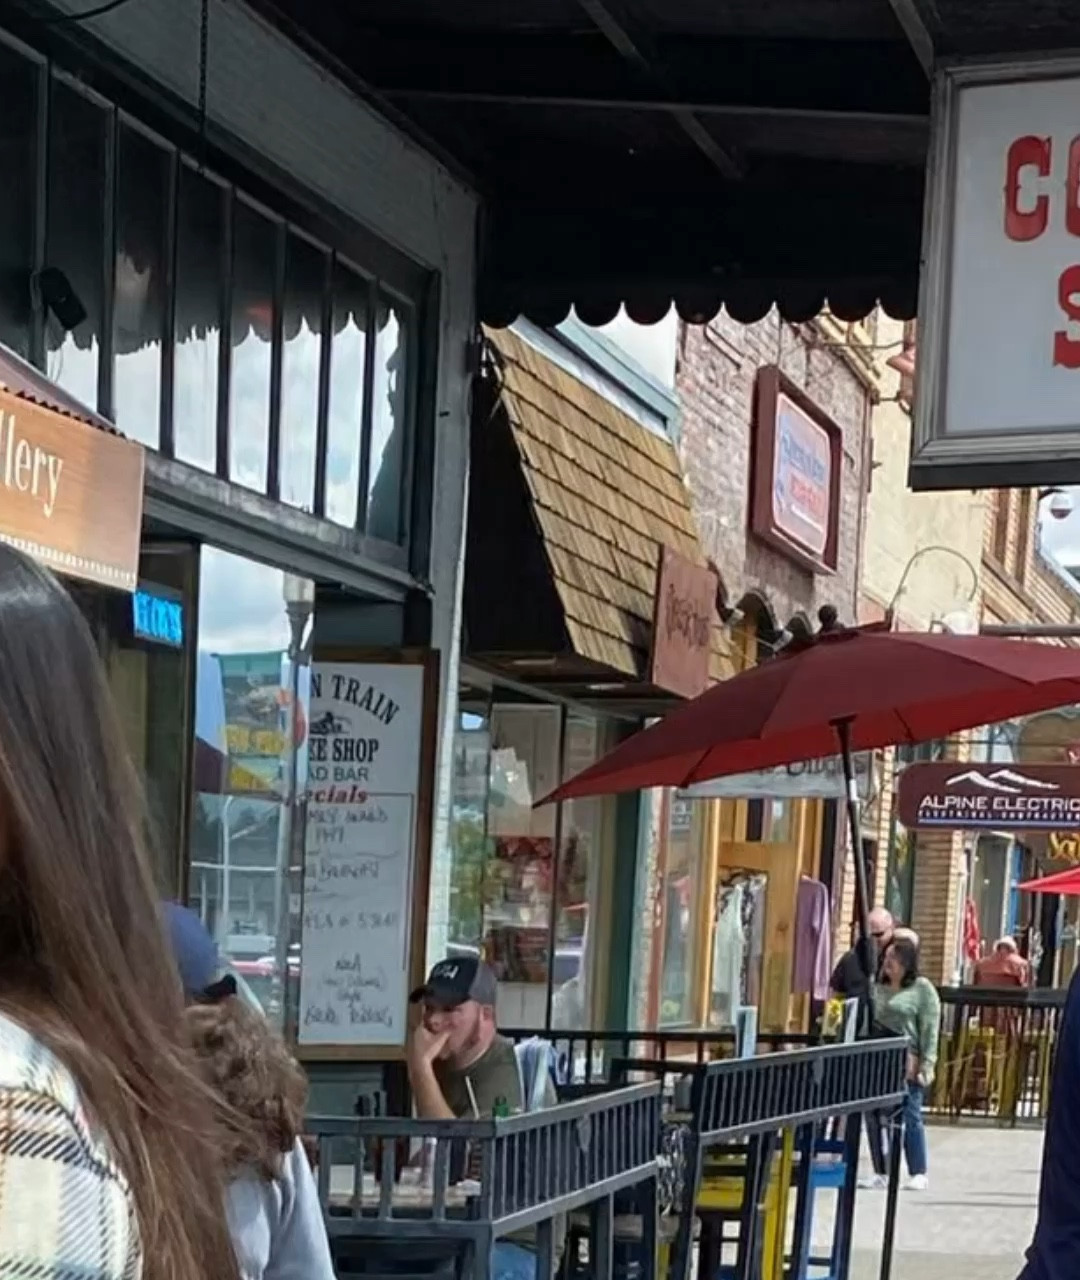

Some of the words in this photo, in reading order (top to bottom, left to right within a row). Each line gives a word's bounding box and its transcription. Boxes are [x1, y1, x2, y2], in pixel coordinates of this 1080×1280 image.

[332, 674, 400, 726] TRAIN
[332, 738, 380, 763] SHOP
[333, 767, 369, 782] BAR
[920, 795, 988, 810] ALPINE
[993, 798, 1080, 812] ELECTRIC
